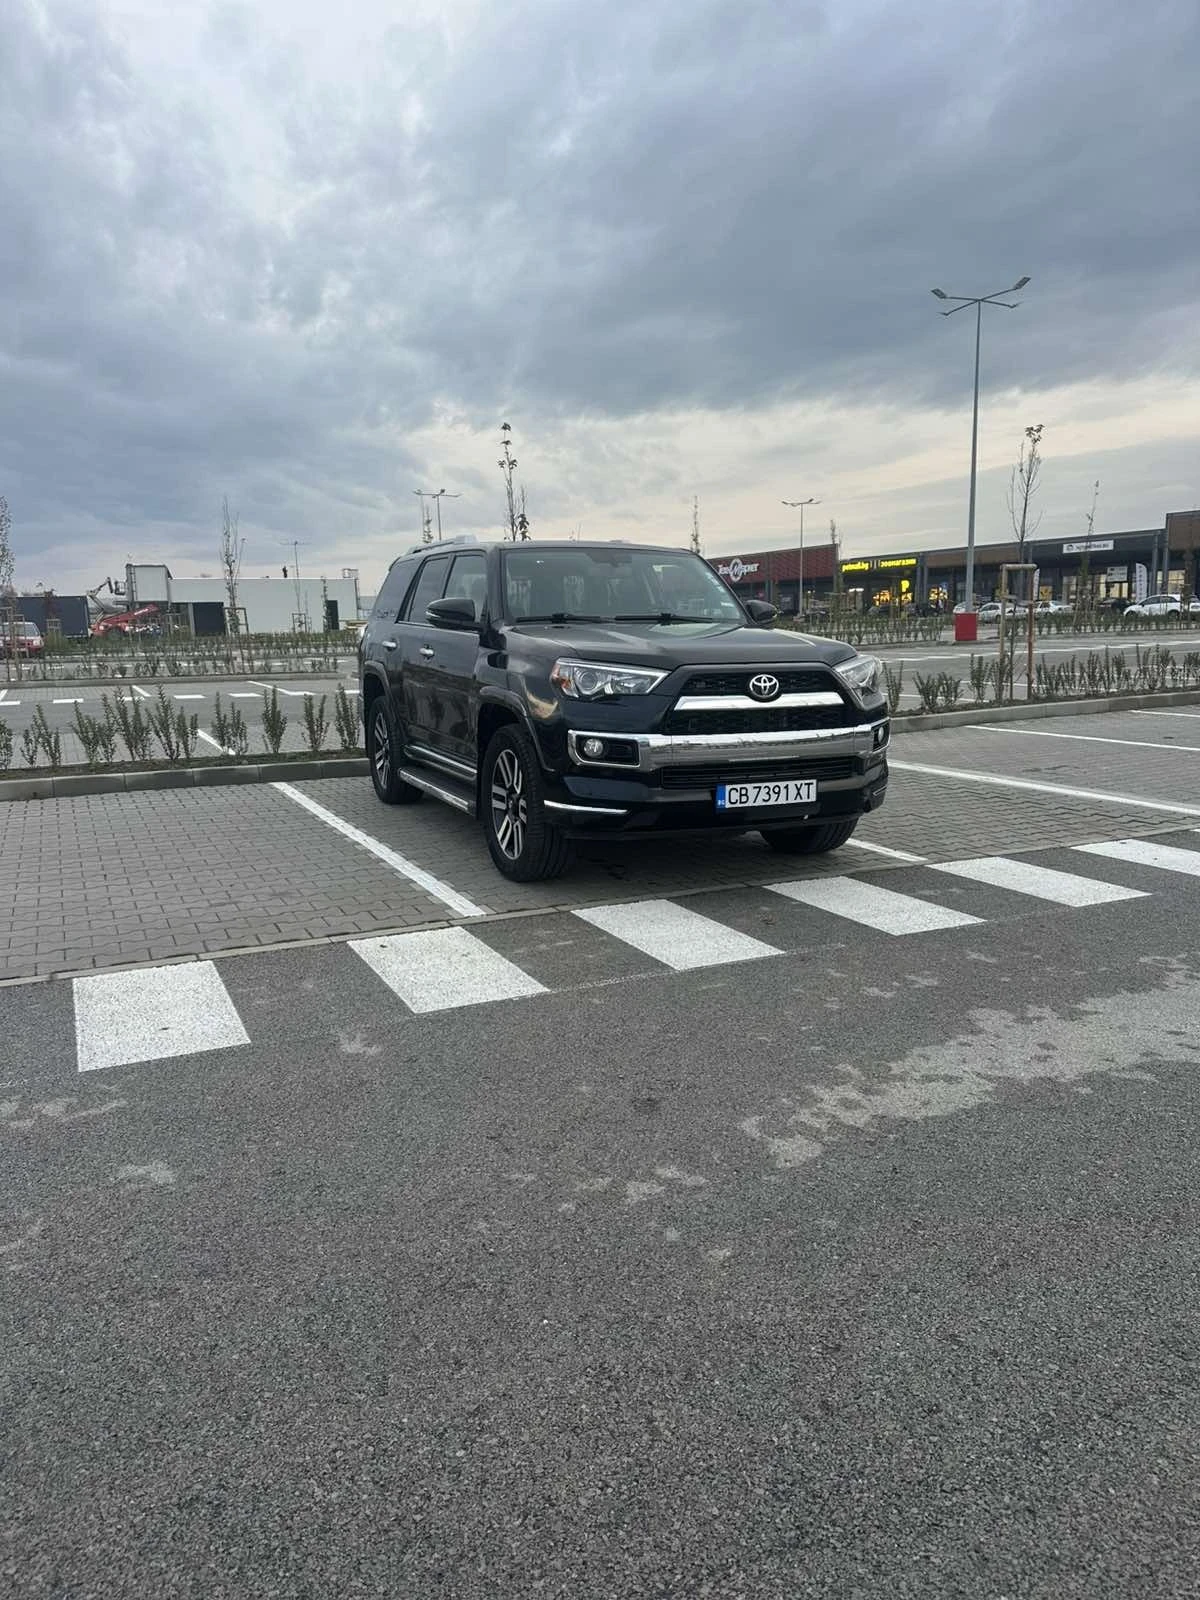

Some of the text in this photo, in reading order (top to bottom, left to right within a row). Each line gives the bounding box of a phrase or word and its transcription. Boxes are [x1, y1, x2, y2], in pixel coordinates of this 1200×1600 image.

[728, 782, 814, 805] CB 7391 XT
